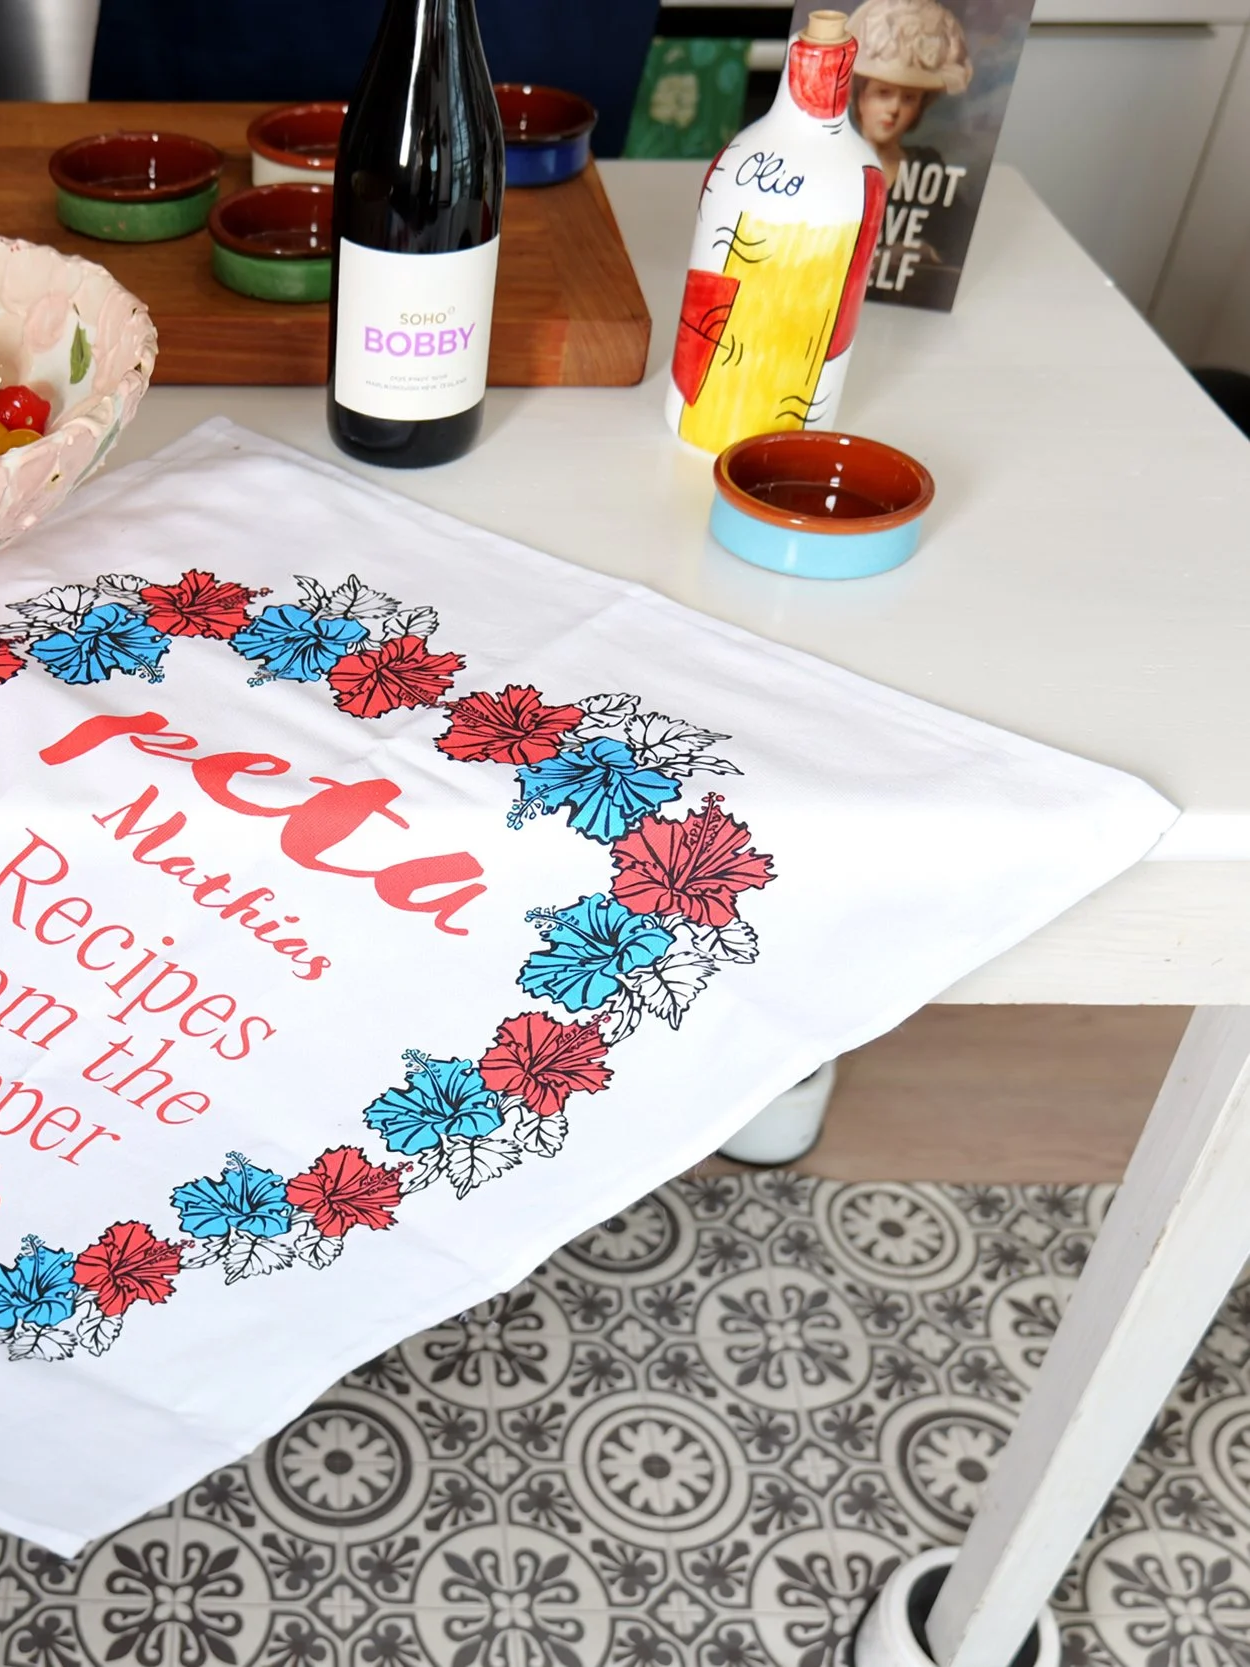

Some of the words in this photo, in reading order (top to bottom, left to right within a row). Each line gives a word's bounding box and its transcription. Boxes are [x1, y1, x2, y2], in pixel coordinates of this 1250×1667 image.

[892, 160, 967, 207] NOT
[878, 205, 929, 248] VE
[364, 322, 476, 357] BOBBY
[400, 312, 447, 325] SOHO
[39, 711, 488, 936] peta
[92, 784, 332, 981] Mathias
[82, 1035, 211, 1126] the
